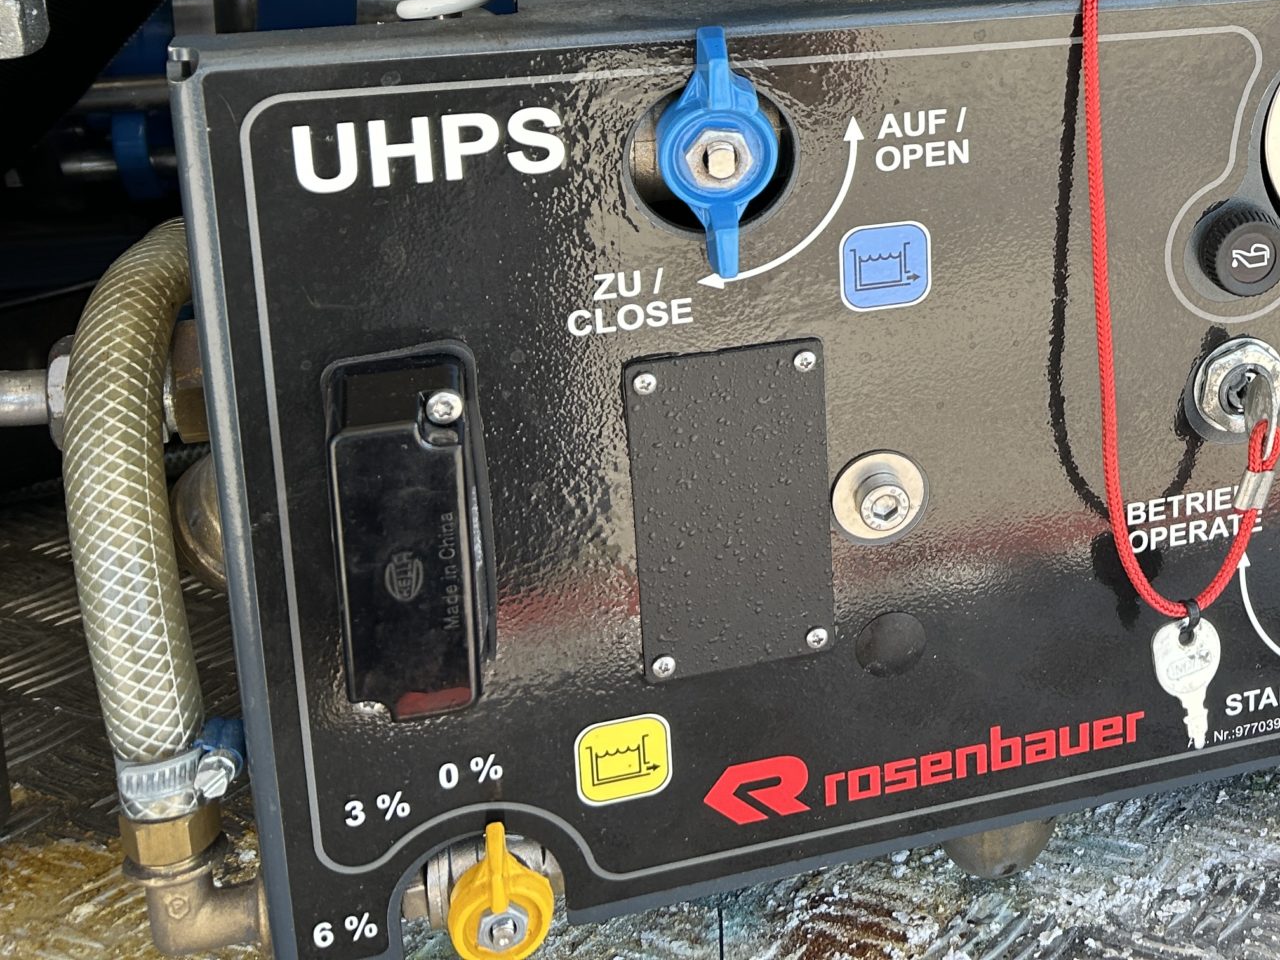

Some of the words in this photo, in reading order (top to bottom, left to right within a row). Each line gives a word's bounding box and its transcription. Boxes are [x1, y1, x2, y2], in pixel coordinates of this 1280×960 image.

[878, 109, 947, 139] AUF
[291, 108, 566, 194] UHPS
[875, 139, 970, 172] OPEN
[594, 272, 642, 300] ZU
[567, 299, 693, 337] CLOSE
[1127, 487, 1240, 526] BETRIE
[438, 512, 455, 559] China
[441, 565, 456, 579] in
[442, 585, 460, 630] Made
[439, 764, 458, 788] 0
[470, 754, 503, 780] %
[825, 711, 1144, 807] rosenbauer
[344, 801, 366, 826] 3
[377, 792, 410, 818] %
[314, 922, 334, 948] 6
[345, 912, 378, 940] %
